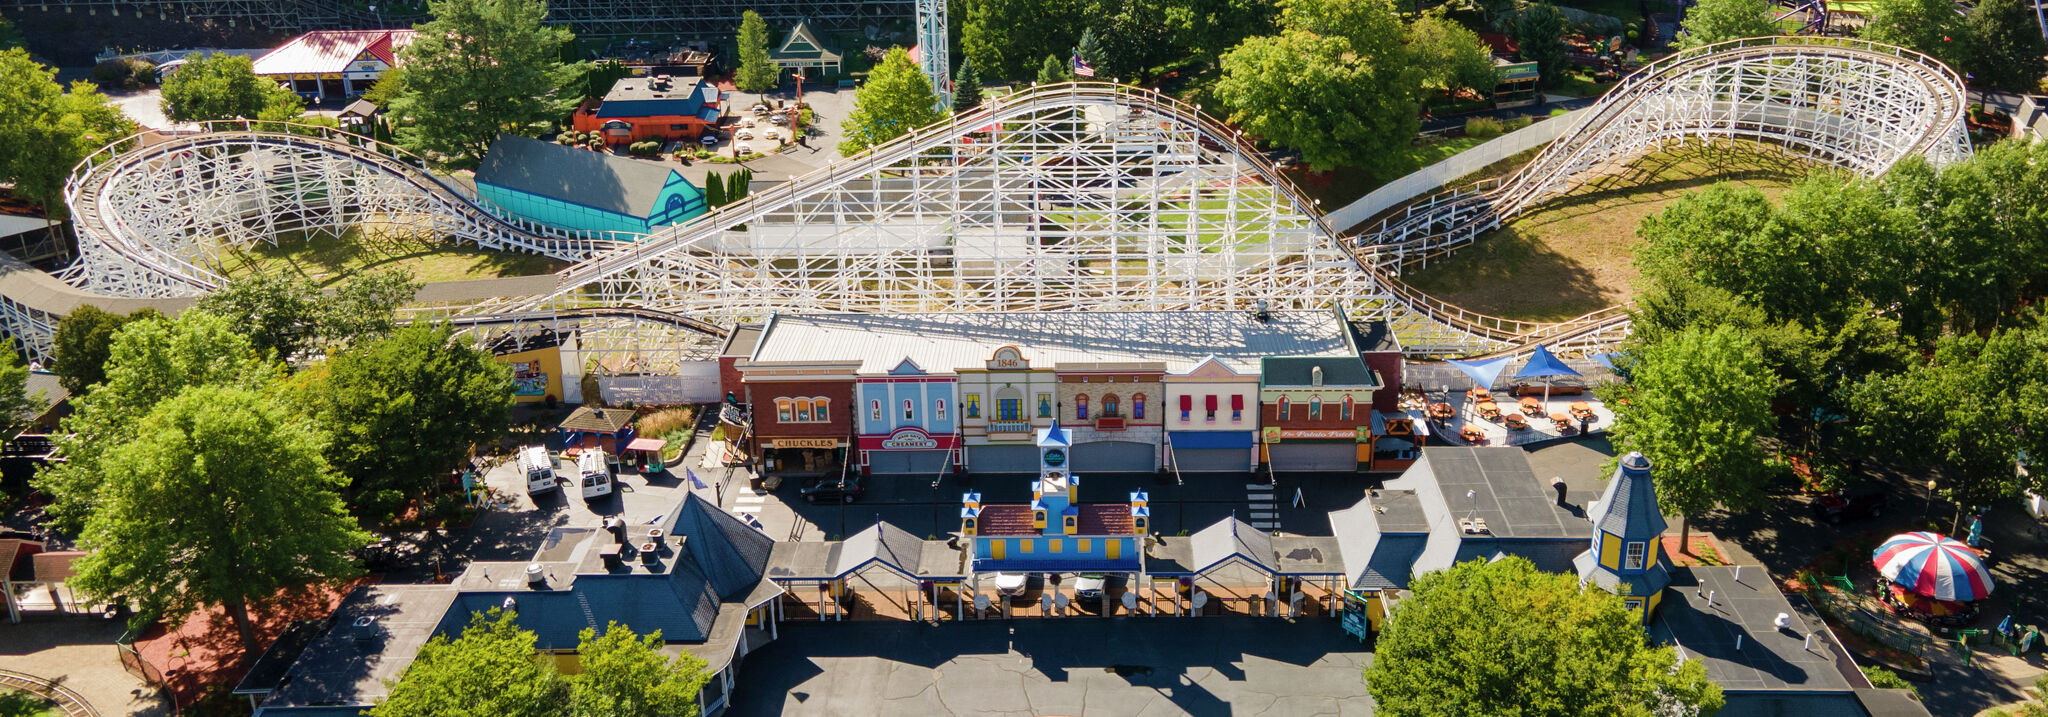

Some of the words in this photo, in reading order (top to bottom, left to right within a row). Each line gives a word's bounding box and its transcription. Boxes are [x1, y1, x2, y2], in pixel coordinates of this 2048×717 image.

[997, 359, 1018, 368] 1846
[1296, 430, 1327, 438] Potato
[1328, 430, 1355, 438] Patch
